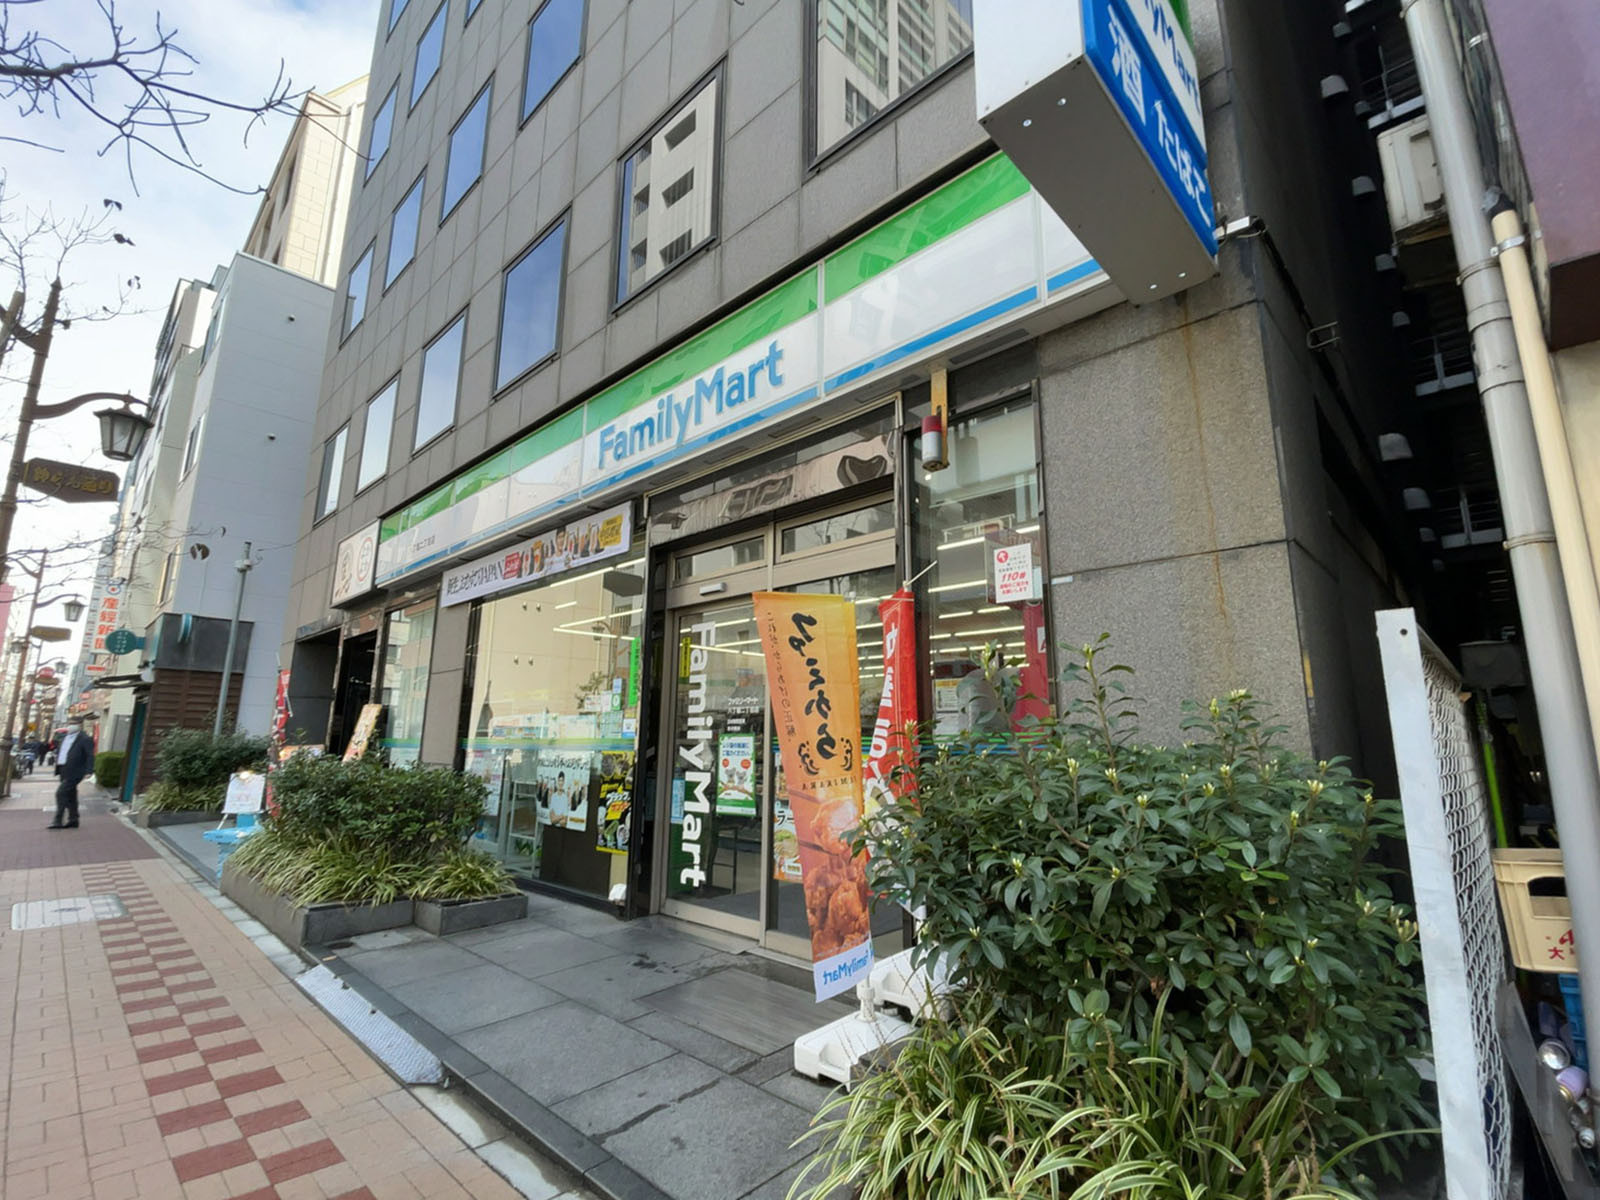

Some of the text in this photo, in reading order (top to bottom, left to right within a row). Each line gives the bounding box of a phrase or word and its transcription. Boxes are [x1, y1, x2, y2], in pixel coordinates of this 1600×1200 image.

[1108, 4, 1146, 127] 酒
[1144, 0, 1202, 114] Mart
[1154, 100, 1211, 228] たばこ
[599, 340, 784, 470] FamilyMart
[679, 621, 716, 888] FamilyMart
